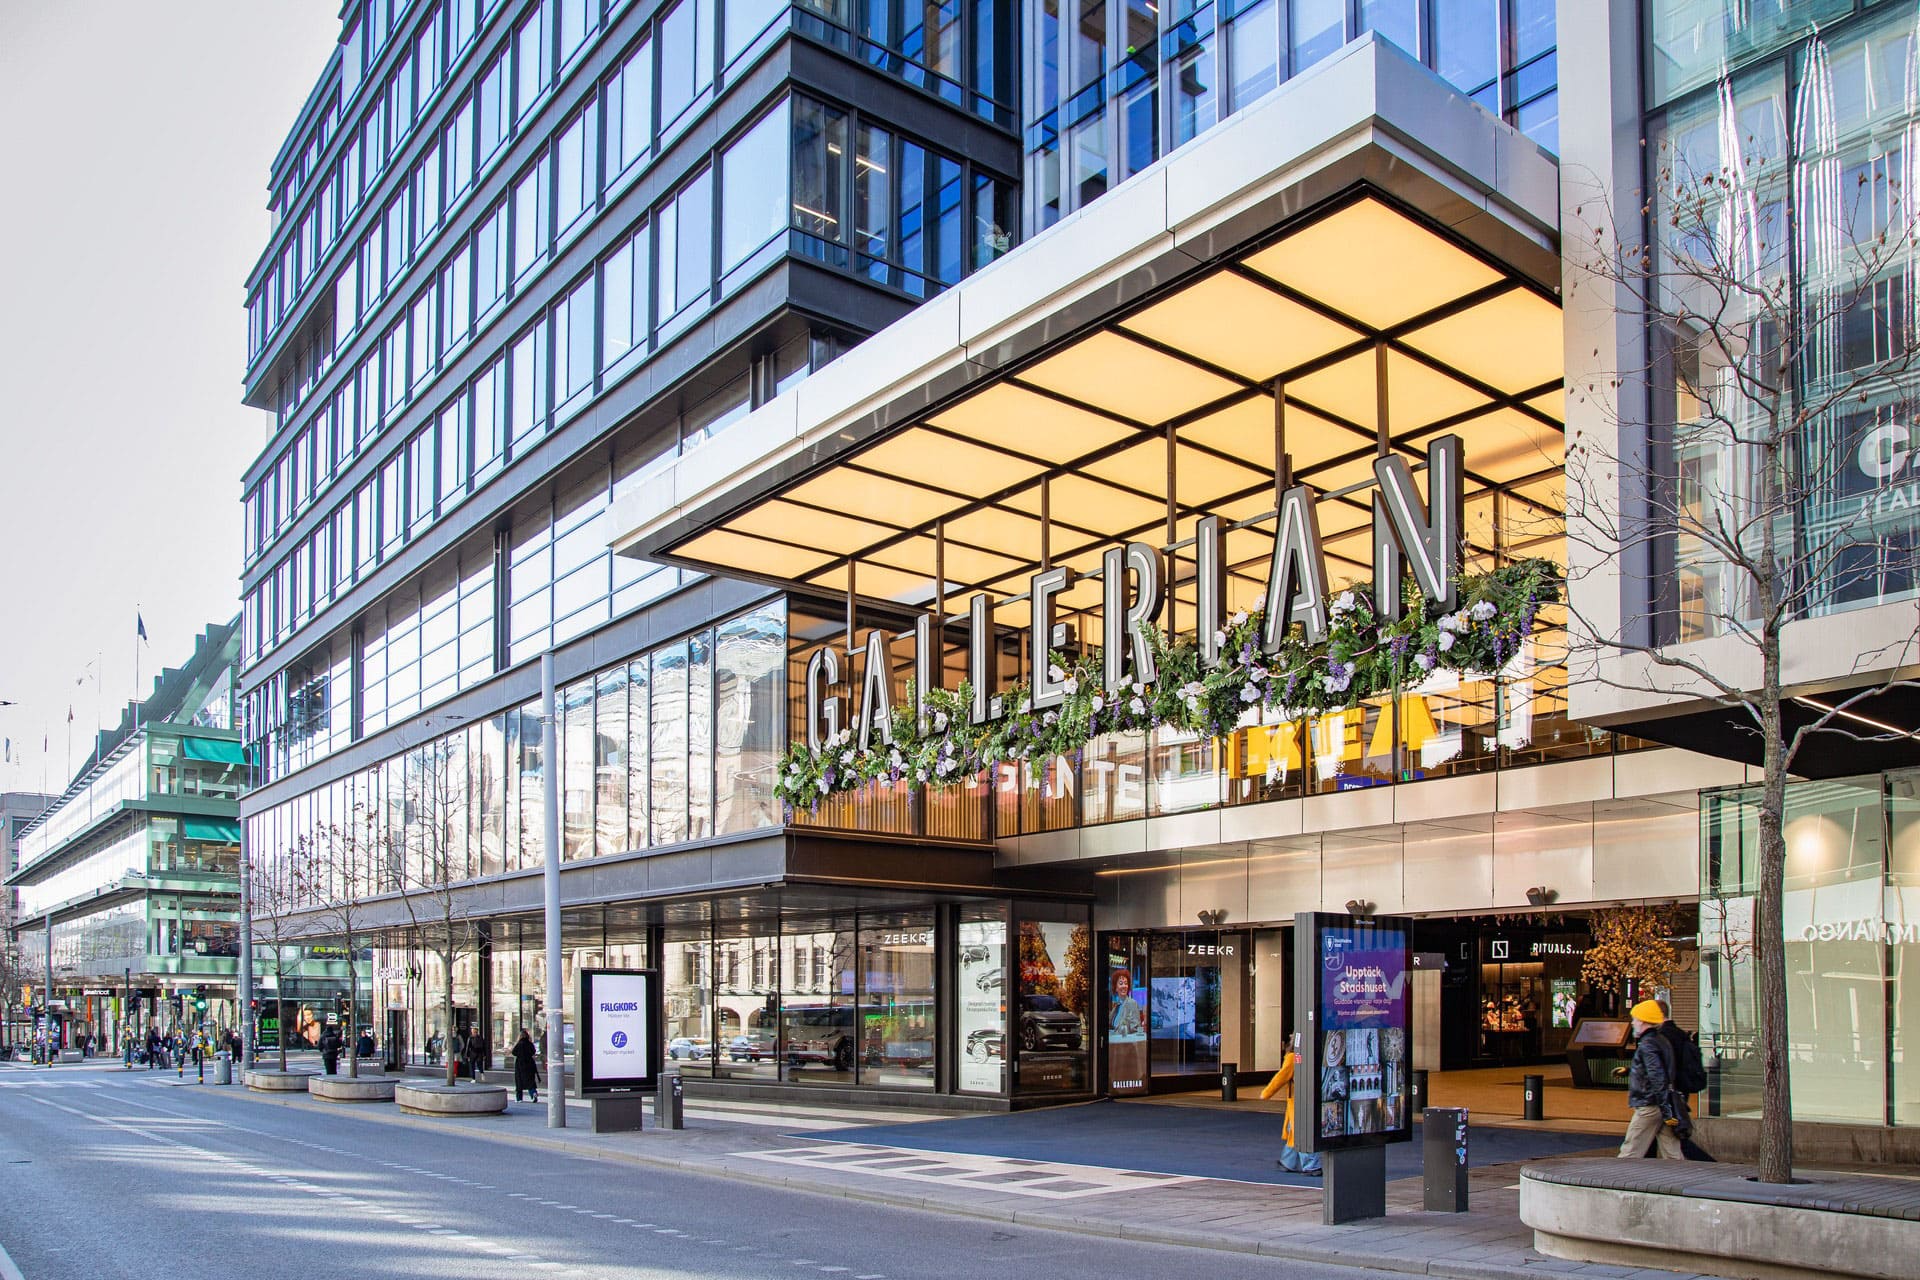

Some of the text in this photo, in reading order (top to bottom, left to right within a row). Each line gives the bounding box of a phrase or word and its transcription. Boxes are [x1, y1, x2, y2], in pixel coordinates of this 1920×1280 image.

[805, 434, 1465, 758] GALLERIAN
[884, 933, 927, 945] ZEEKR
[1187, 944, 1235, 956] ZEEKR
[1345, 965, 1381, 980] Upptäck
[1340, 981, 1387, 993] Stadshuset
[600, 1002, 638, 1012] FÄLGKORS
[1112, 1080, 1143, 1089] GALLERIAN
